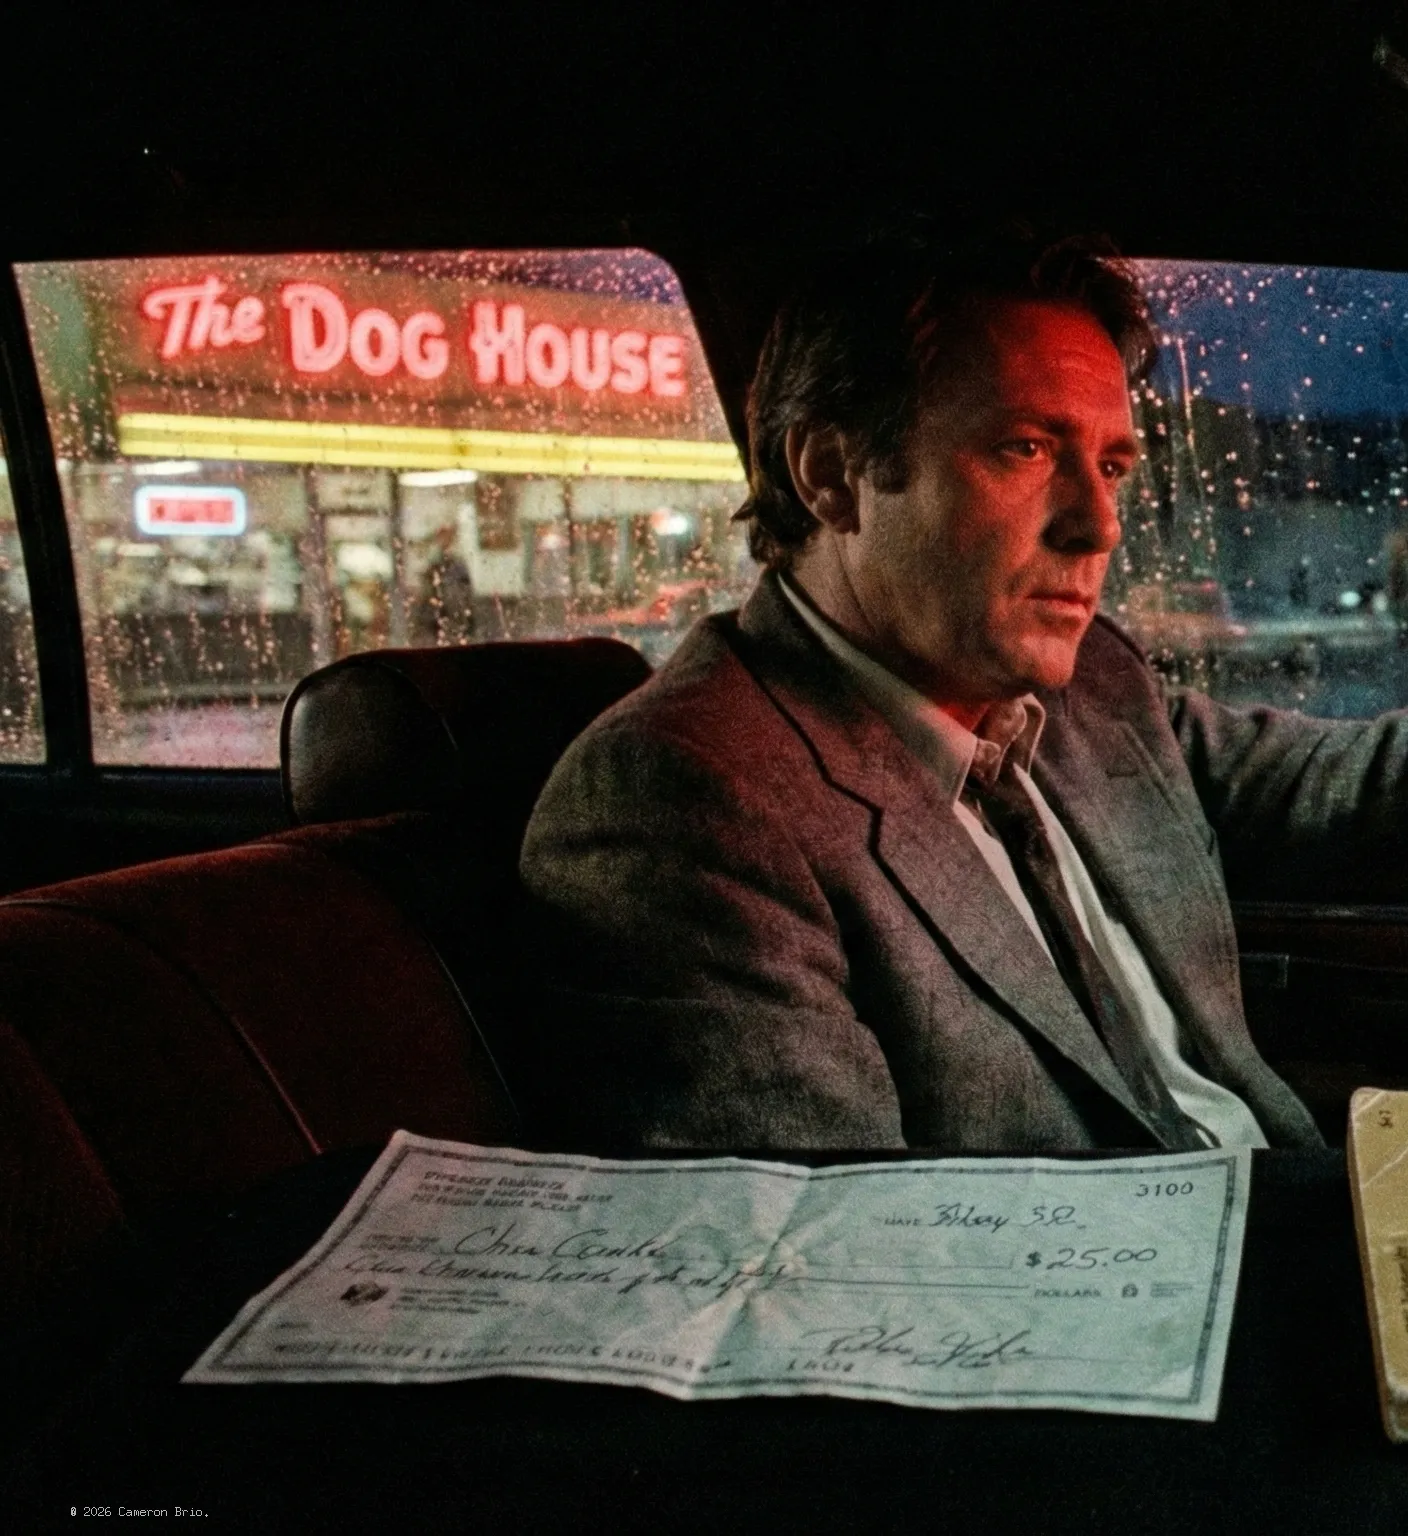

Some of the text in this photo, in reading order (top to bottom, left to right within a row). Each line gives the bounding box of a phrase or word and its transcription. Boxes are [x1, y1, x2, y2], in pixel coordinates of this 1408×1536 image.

[142, 276, 265, 360] The
[1135, 1181, 1194, 1198] 3100
[1025, 1247, 1158, 1271] $25.00
